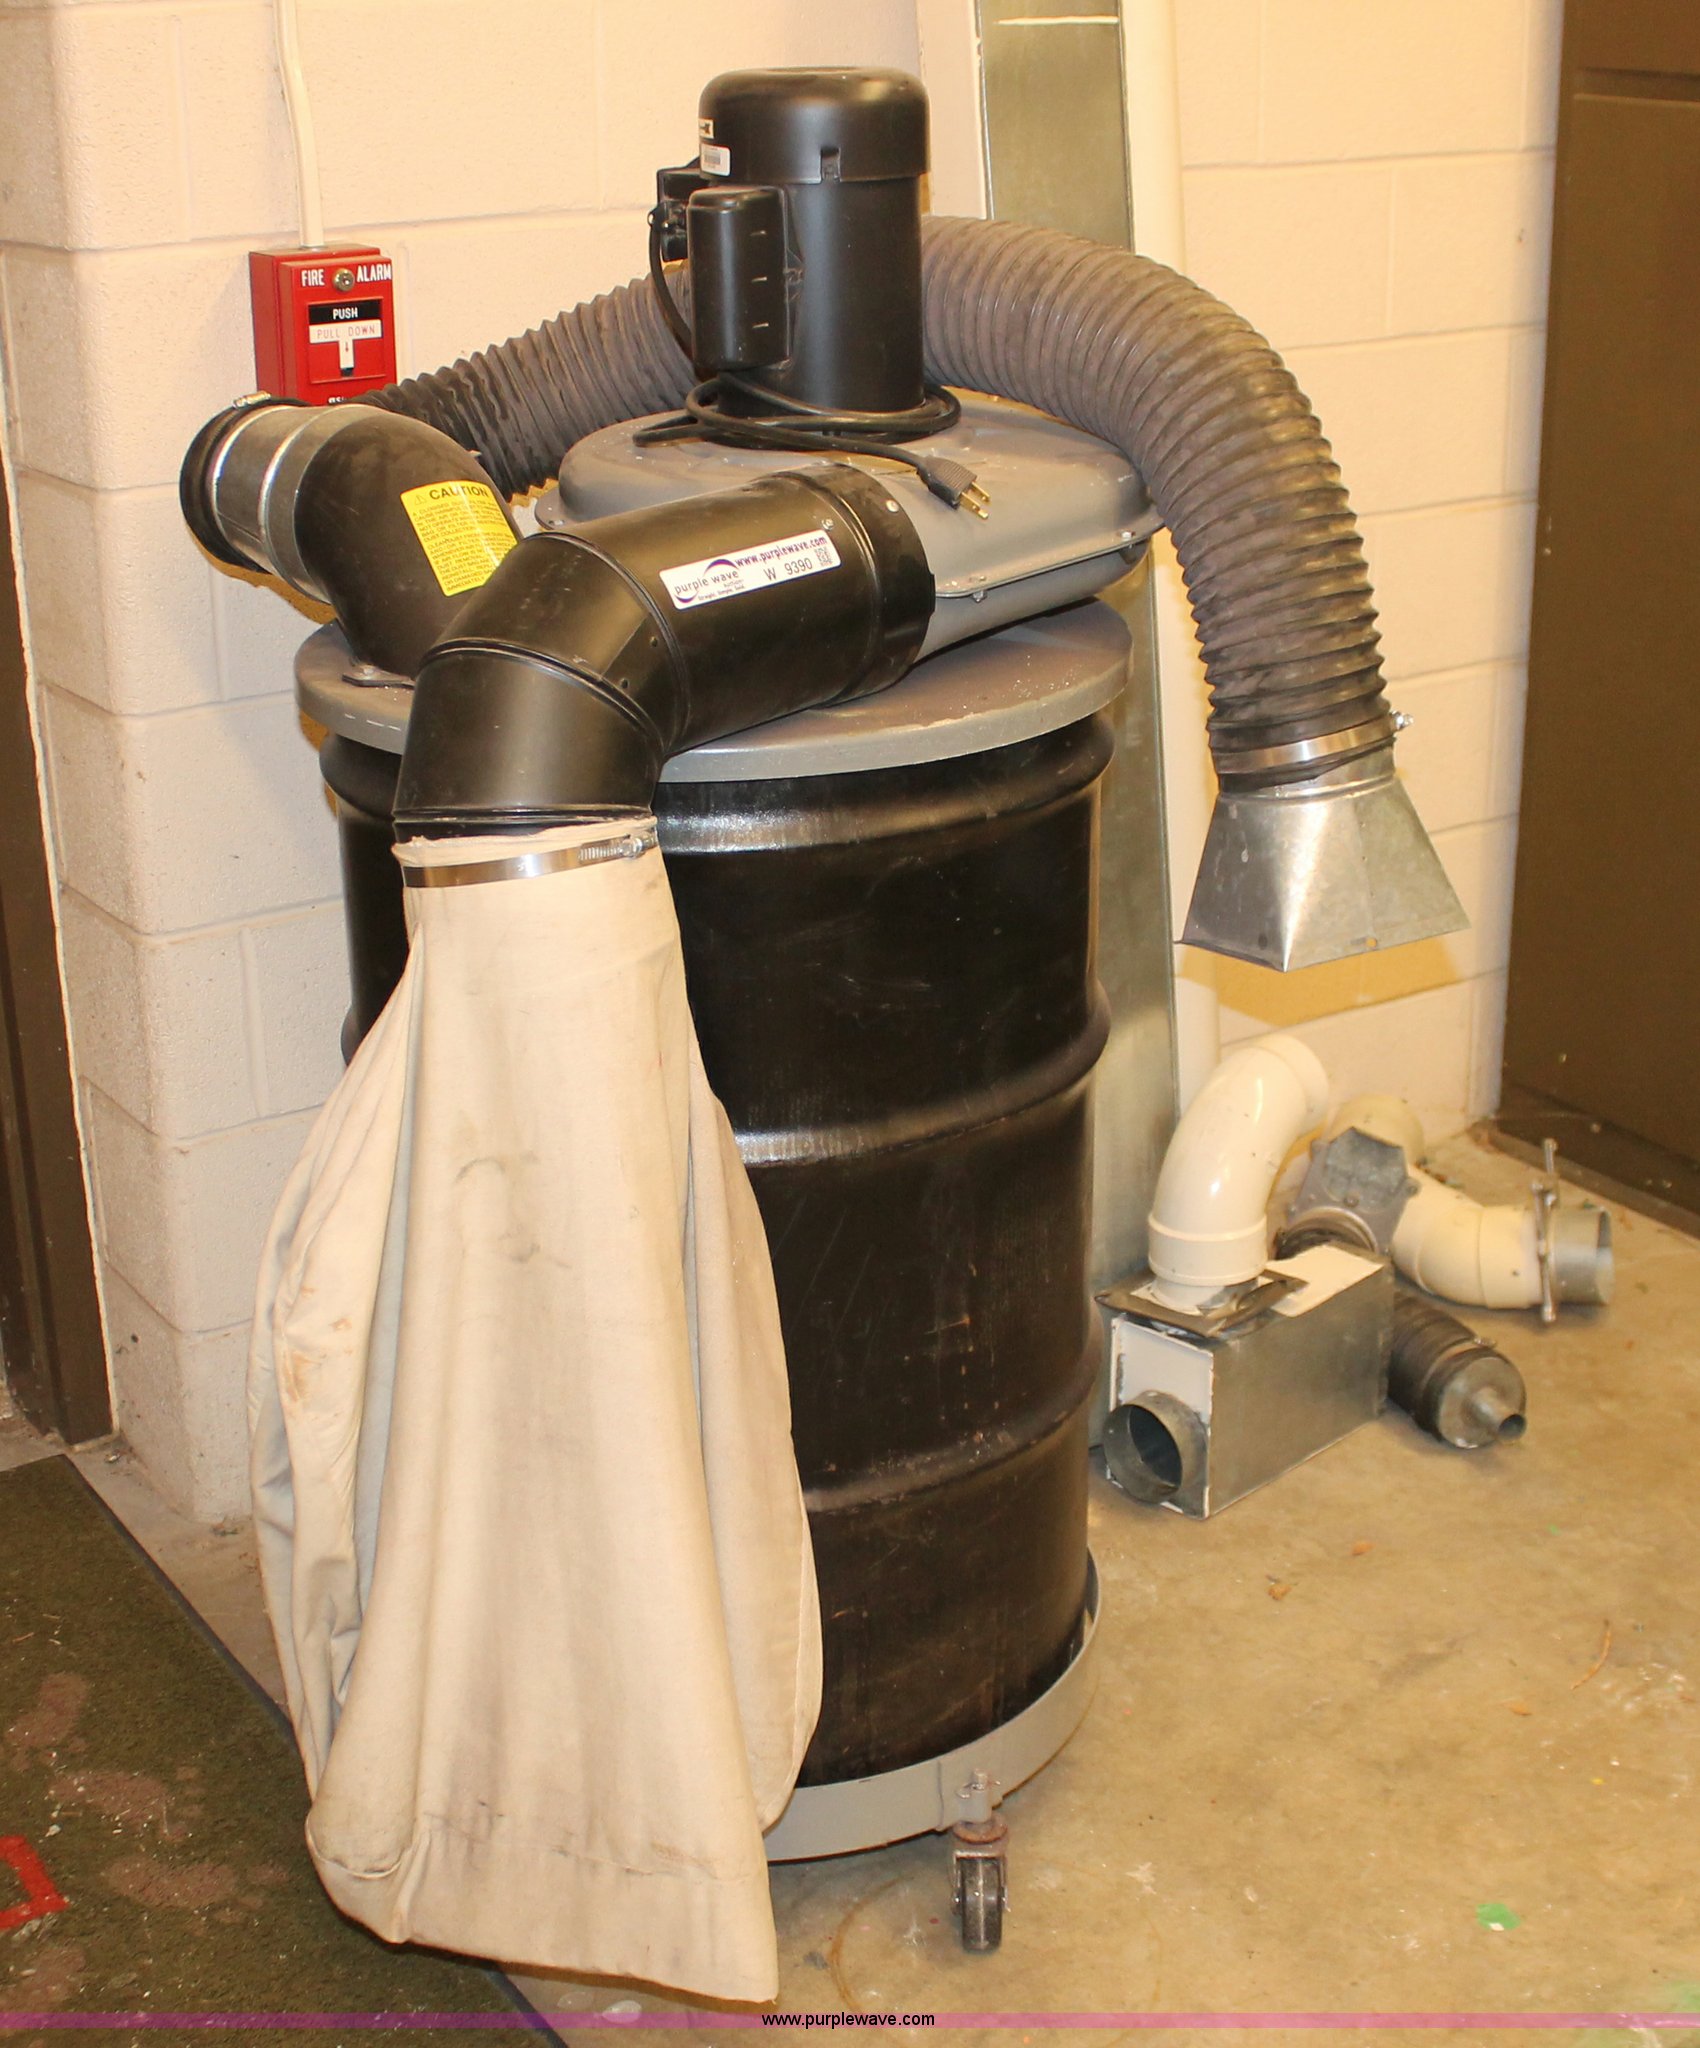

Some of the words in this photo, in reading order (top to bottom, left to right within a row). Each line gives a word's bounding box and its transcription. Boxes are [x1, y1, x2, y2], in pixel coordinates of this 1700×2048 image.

[301, 268, 325, 287] FIRE
[356, 263, 392, 283] ALARM
[332, 307, 359, 320] PUSH
[317, 328, 340, 339] PULL
[348, 325, 375, 337] DOWN
[429, 486, 489, 499] CAUTION
[735, 536, 827, 567] www.purplewave.com
[763, 566, 777, 581] W
[784, 557, 813, 576] 9390
[674, 578, 709, 595] purple
[711, 570, 739, 584] wave
